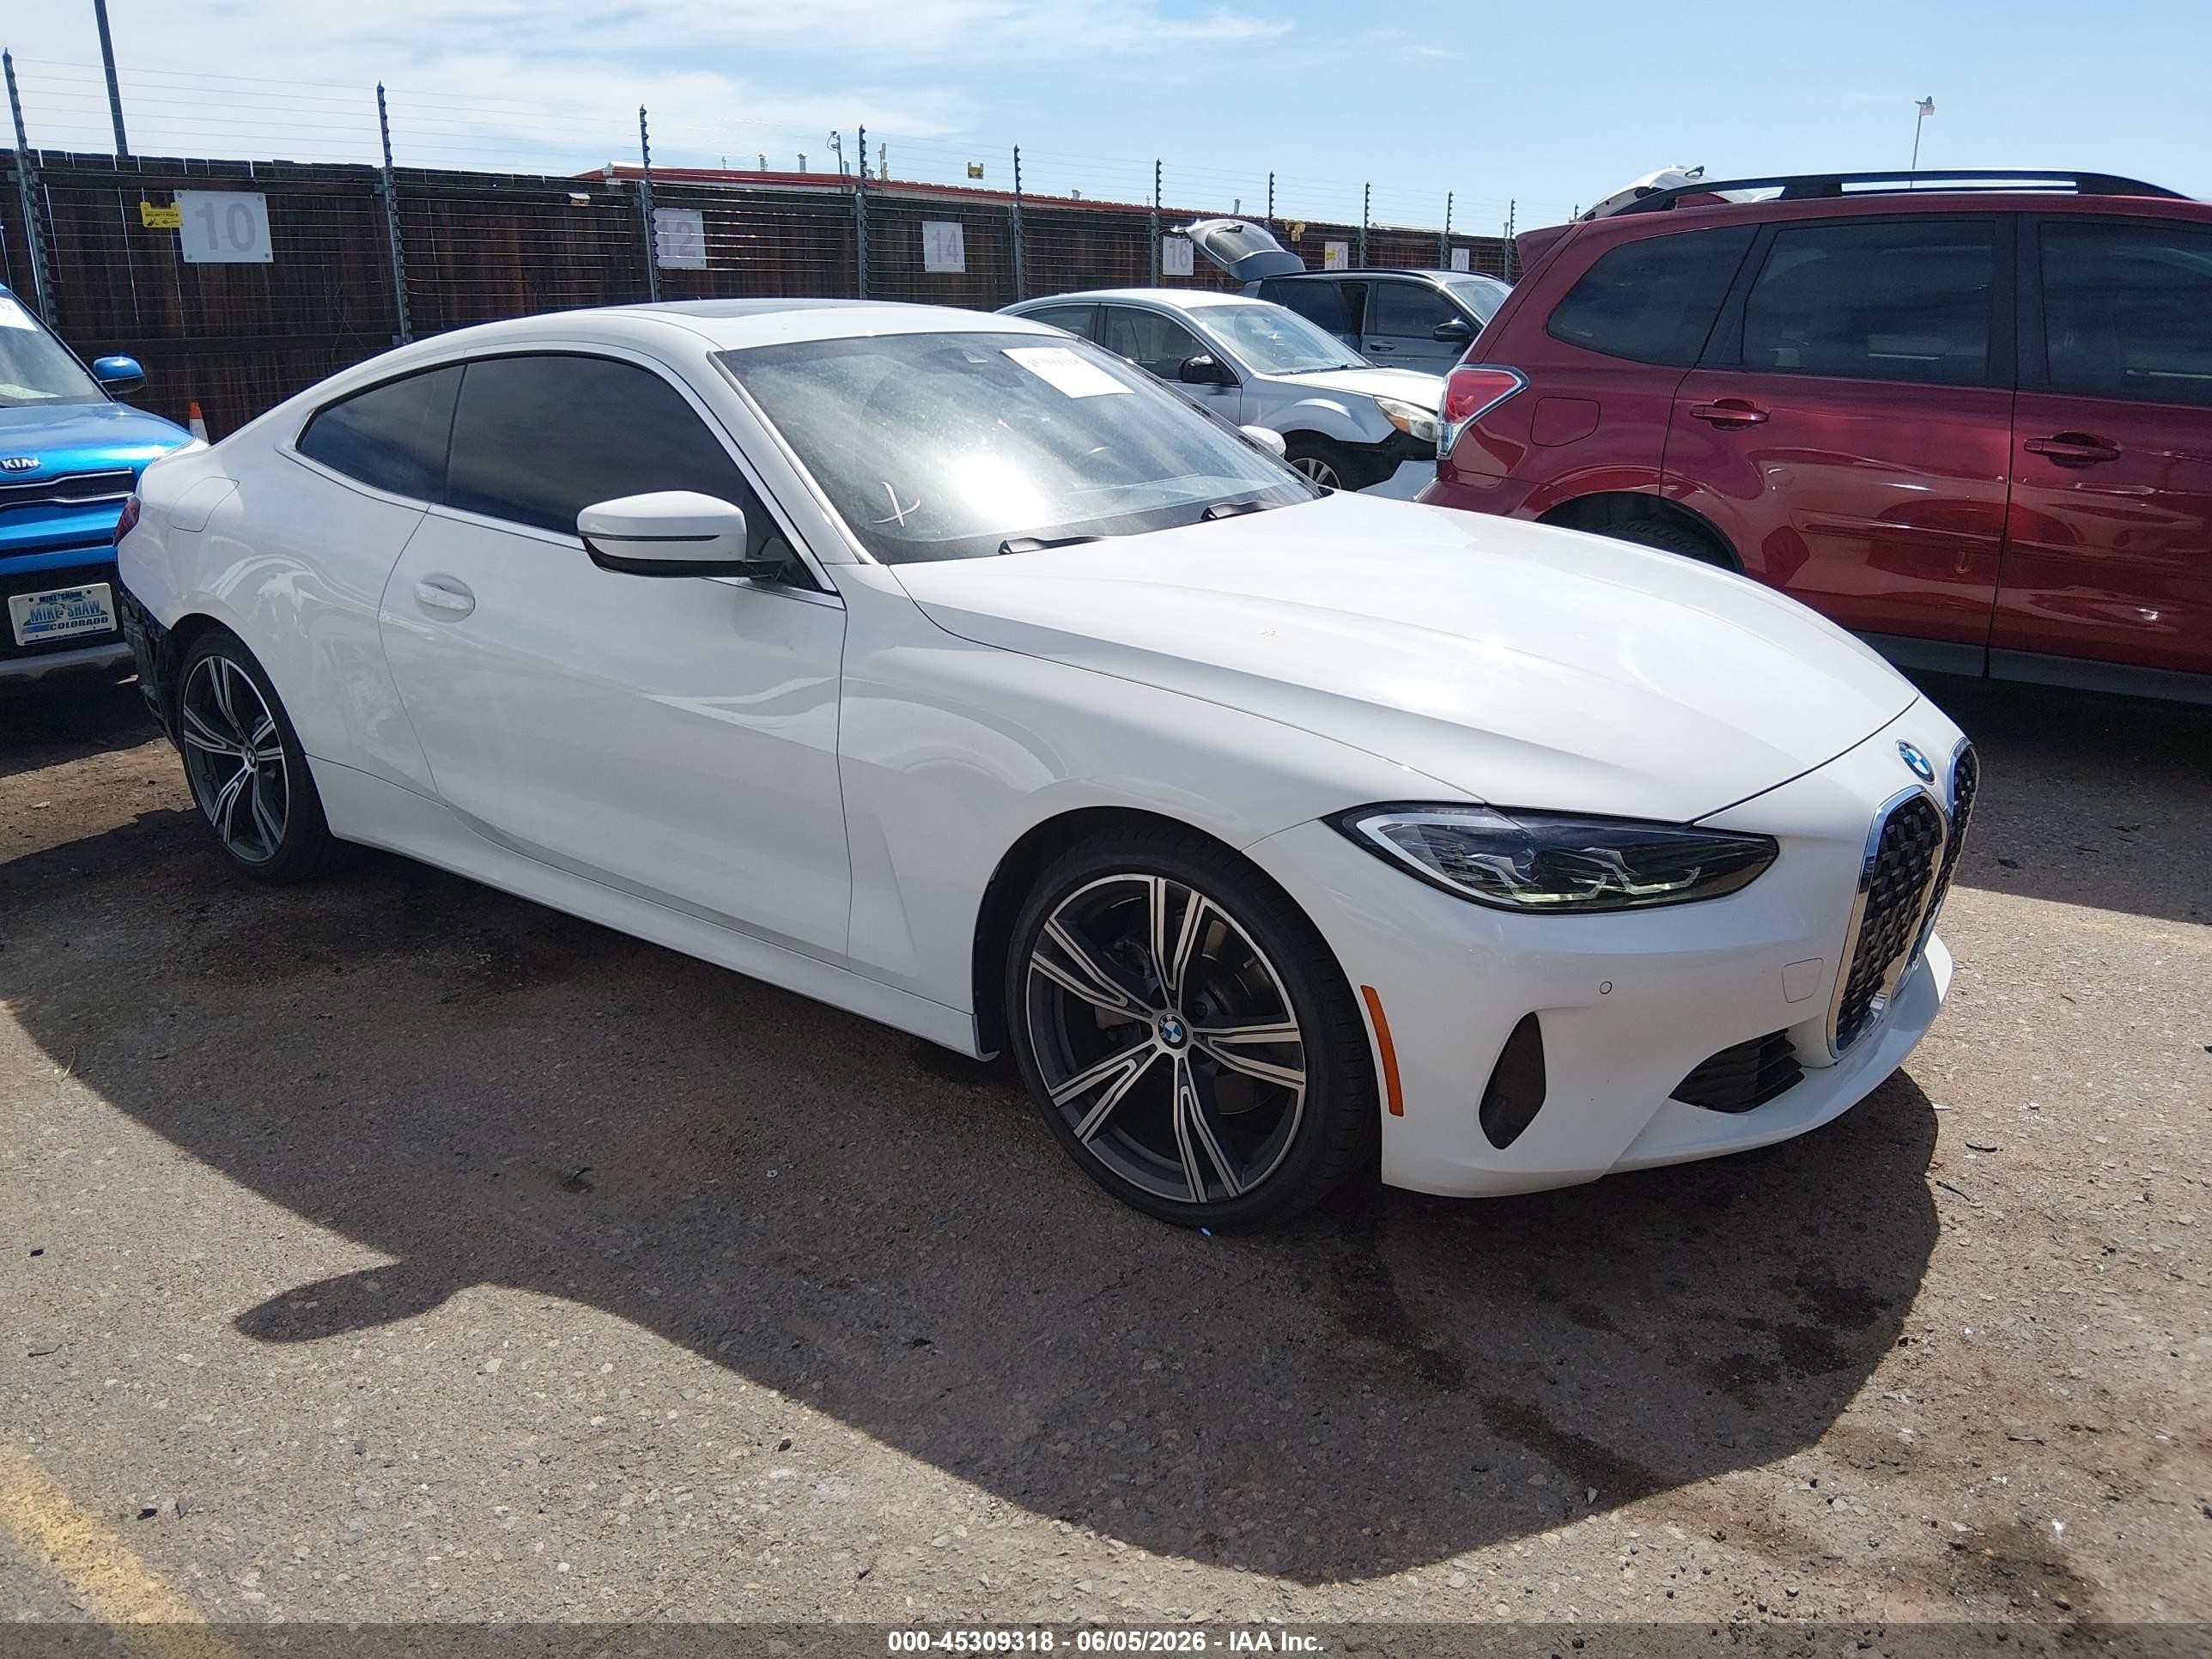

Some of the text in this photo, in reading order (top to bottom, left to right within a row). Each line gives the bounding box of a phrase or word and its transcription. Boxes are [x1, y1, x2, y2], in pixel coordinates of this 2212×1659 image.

[195, 202, 256, 252] 10
[655, 220, 696, 257] 12
[932, 229, 959, 264] 14
[1169, 240, 1189, 269] 16
[2, 459, 39, 469] KIA
[39, 590, 83, 603] MIKE SHAW
[30, 599, 100, 623] MIKE SHAW
[50, 617, 108, 630] COLORADO
